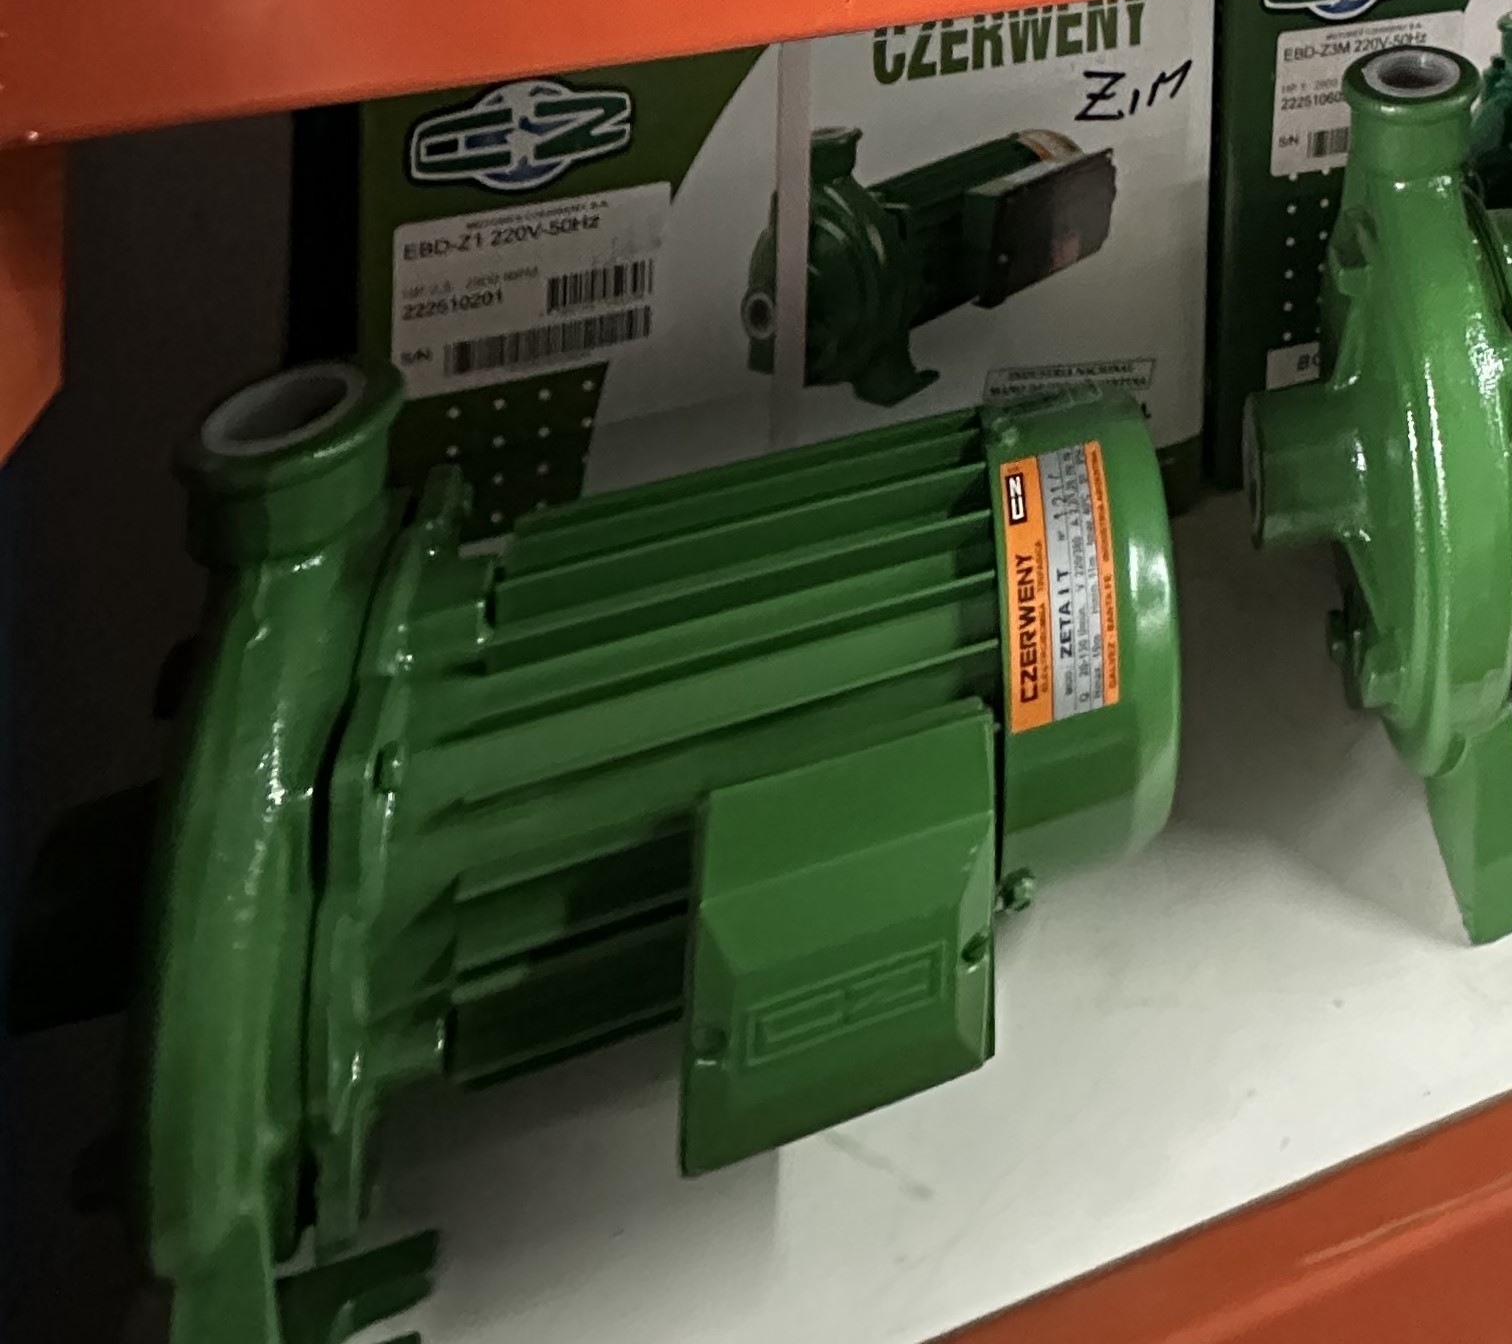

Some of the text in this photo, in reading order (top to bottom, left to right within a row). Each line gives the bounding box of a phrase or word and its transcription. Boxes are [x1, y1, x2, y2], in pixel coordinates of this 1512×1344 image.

[1283, 41, 1350, 62] EBD-Z3M
[1015, 553, 1040, 703] CZERWENY
[1056, 600, 1073, 660] ZETA
